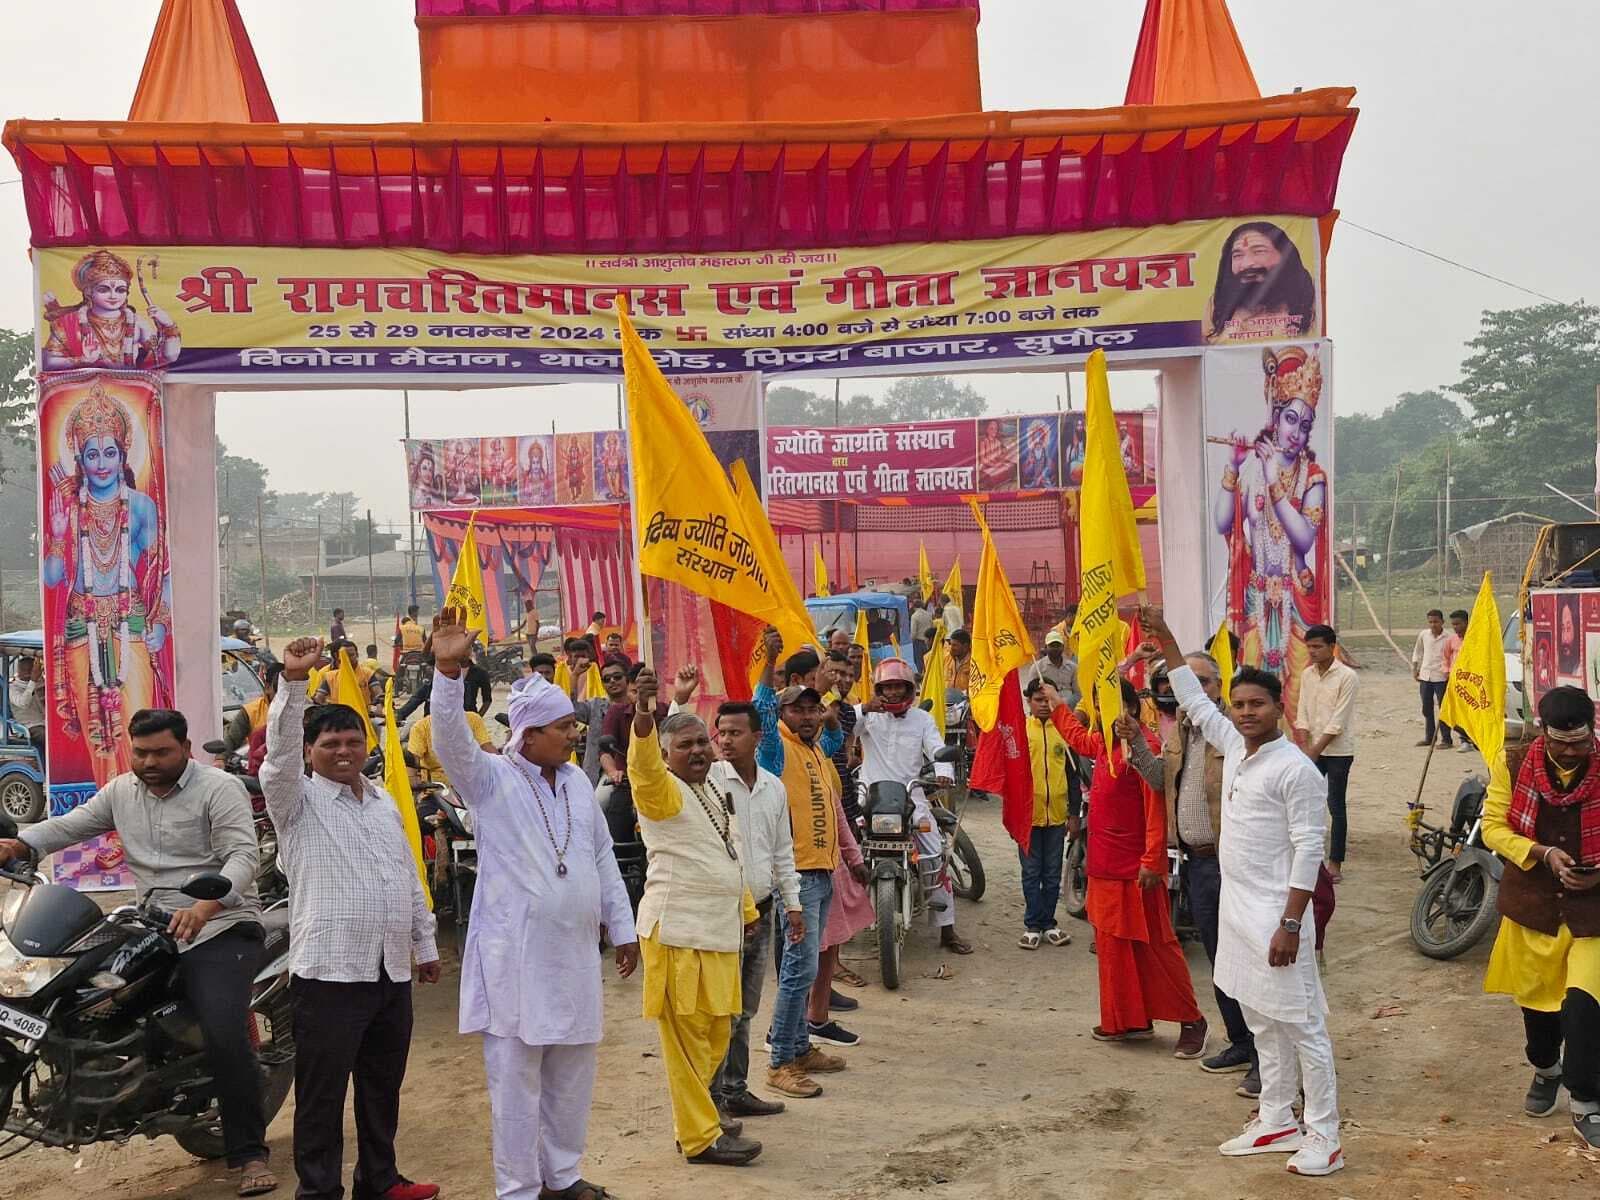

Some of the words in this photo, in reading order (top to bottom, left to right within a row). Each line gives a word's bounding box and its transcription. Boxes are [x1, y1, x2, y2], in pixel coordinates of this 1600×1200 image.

[599, 257, 638, 269] सर्वश्री
[700, 255, 752, 268] महाराज
[755, 254, 774, 265] जी
[777, 250, 796, 265] की
[176, 266, 258, 314] श्री
[277, 268, 689, 317] रामचरितमानस
[708, 269, 804, 316] एवं
[820, 265, 960, 311] गीता
[980, 252, 1196, 300] ज्ञानयज्ञ
[308, 324, 341, 338] 25
[348, 320, 377, 339] से
[386, 324, 419, 338] 29
[428, 325, 533, 340] नवम्बर
[540, 326, 605, 341] 2024
[722, 324, 777, 340] संध्या
[782, 323, 829, 338] 4:00
[837, 318, 874, 336] बजे
[880, 317, 900, 333] से
[906, 314, 958, 330] संध्या
[965, 310, 1012, 326] 7:00
[1018, 304, 1056, 323] बजे
[1062, 305, 1102, 320] तक
[238, 348, 379, 367] विनोवा
[389, 347, 522, 369] मैदान,
[539, 353, 623, 369] थान
[863, 338, 999, 360] बाजार,
[1013, 326, 1138, 356] सुपौल
[773, 430, 825, 455] ज्योति
[895, 425, 955, 450] संस्थान
[767, 466, 839, 496] रितमानस
[843, 464, 867, 493] एवं
[873, 462, 908, 492] गीता
[914, 466, 974, 491] ज्ञानयज्ञ
[643, 511, 682, 548] दिव्य
[684, 513, 728, 551] ज्योति
[676, 546, 737, 584] संस्थान
[0, 1008, 43, 1037] Q-4085
